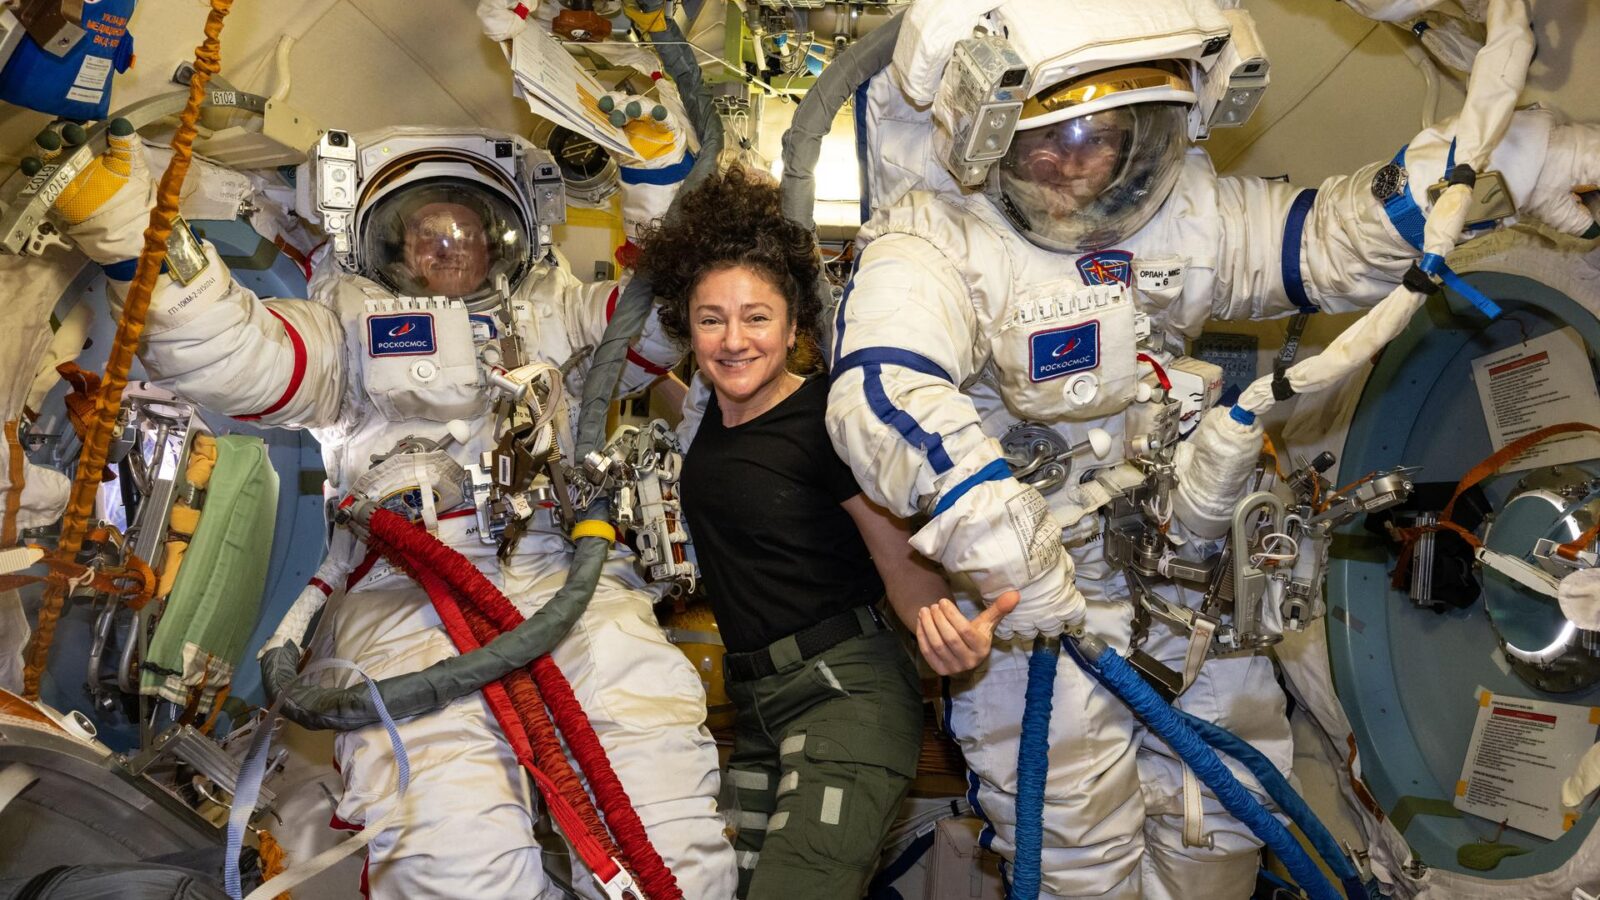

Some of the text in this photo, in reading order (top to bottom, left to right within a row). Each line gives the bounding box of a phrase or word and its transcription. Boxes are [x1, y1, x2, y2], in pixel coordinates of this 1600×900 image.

[214, 92, 234, 104] 6102
[25, 166, 56, 191] 6102
[43, 171, 69, 203] 6102
[1140, 270, 1163, 279] ОРЛАН
[1163, 278, 1169, 286] 6
[378, 341, 428, 349] РОСКОСМОС
[1040, 355, 1091, 373] РОСКОСМОС
